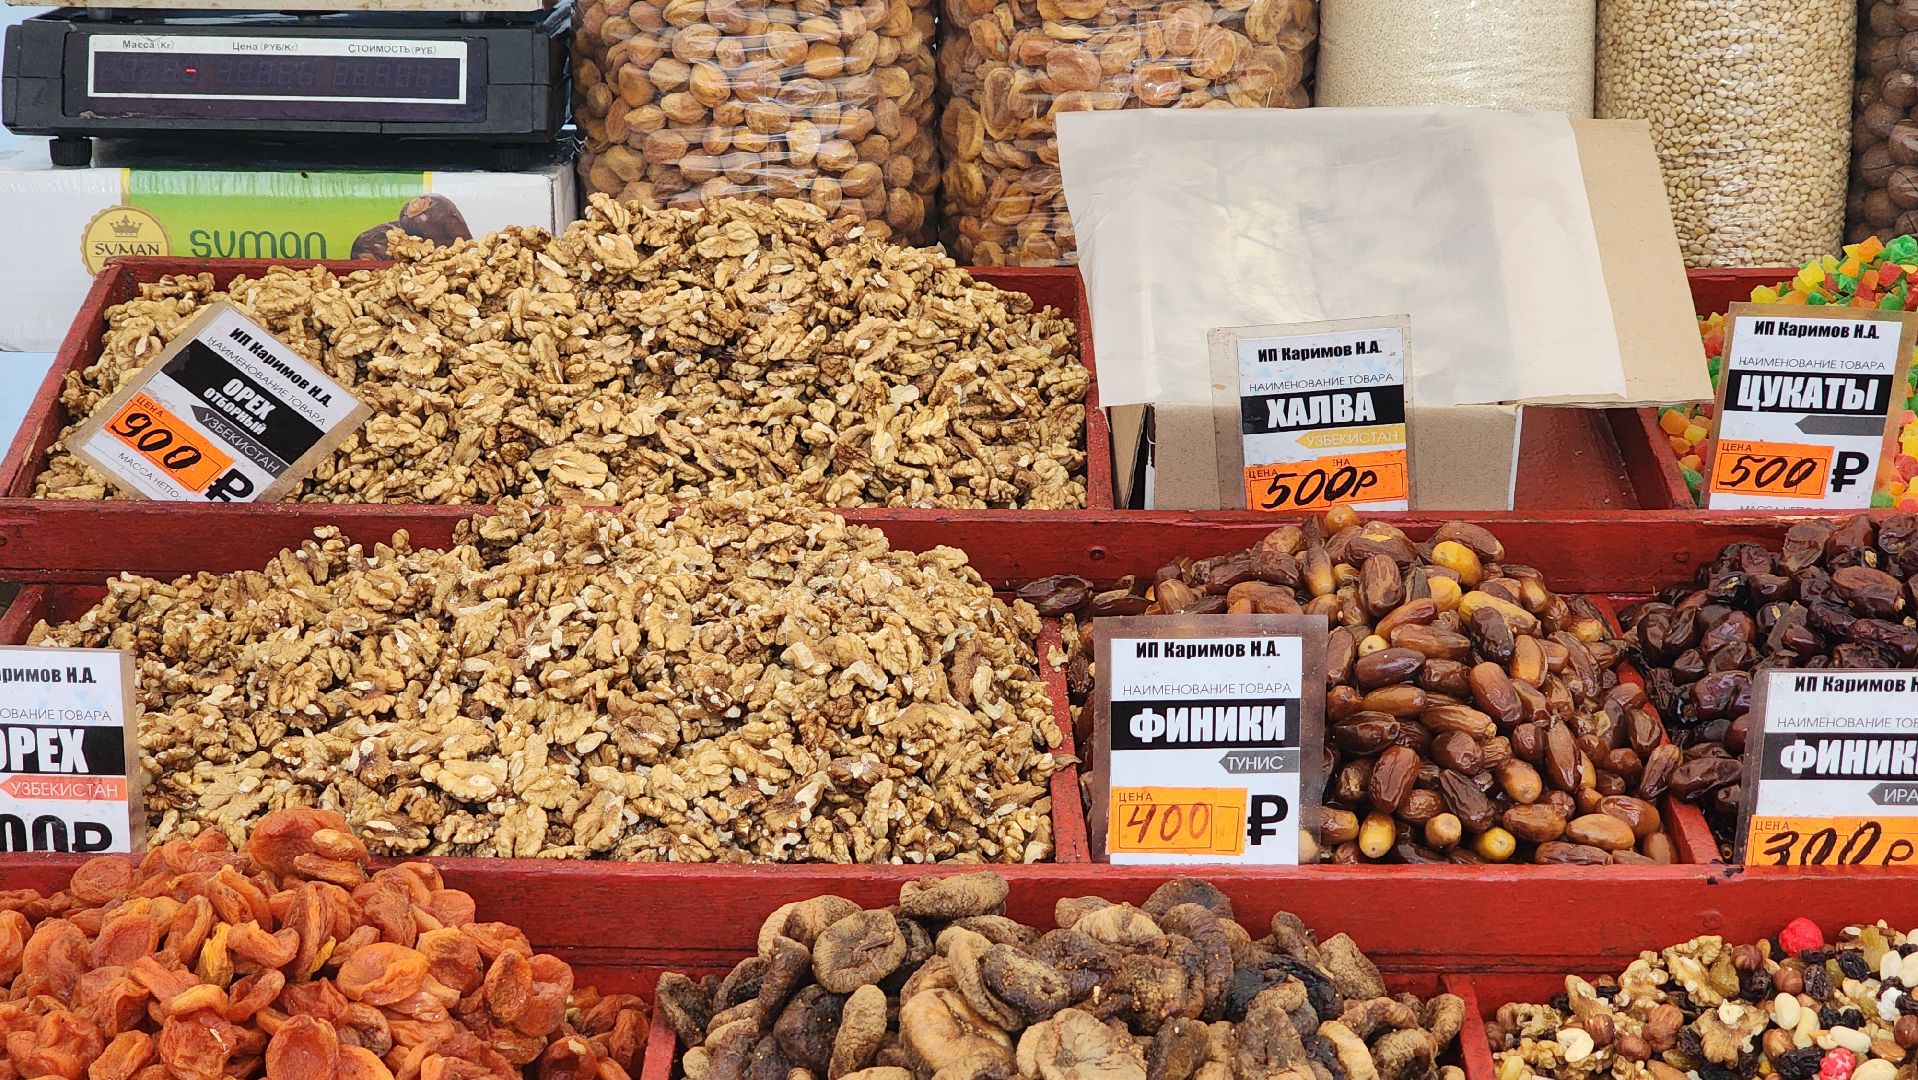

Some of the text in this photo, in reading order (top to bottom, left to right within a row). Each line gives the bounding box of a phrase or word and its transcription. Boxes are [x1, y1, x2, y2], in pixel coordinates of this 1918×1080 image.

[122, 40, 154, 49] Масса
[232, 42, 258, 52] Цена
[1754, 320, 1880, 339] ИП Каримов Н.А.
[229, 328, 252, 347] ИП
[248, 341, 309, 390] Каримов
[1258, 340, 1383, 363] ИП Каримов Н.А.
[1739, 357, 1885, 370] НАИМЕНОВАНИЕ ТОВАРА
[207, 336, 326, 426] НАИМЕНОВАНИЕ ТОВАРА
[1249, 373, 1394, 392] НАИМЕНОВАНИЕ ТОВАРА
[222, 378, 277, 421] ОРЕХ
[1736, 374, 1880, 412] ЦУКАТЫ
[136, 396, 164, 418] ЦЕНА
[203, 387, 268, 436] ОТБОРНЫЙ
[1265, 391, 1377, 429] ХАЛВА
[111, 412, 202, 470] 900
[202, 412, 280, 474] УЗБЕКИСТАН
[1306, 431, 1399, 447] УЗБЕКИСТАН
[1722, 443, 1752, 452] ЦЕНА
[118, 452, 153, 481] МАССА
[1248, 468, 1278, 479] ЦЕНА
[1719, 455, 1817, 489] 500
[1136, 640, 1281, 660] ИП Каримов Н.А.
[0, 666, 97, 683] римов Н.А.
[1123, 682, 1292, 696] НАИМЕНОВАНИЕ ТОВАРА
[1794, 676, 1818, 693] ИП
[1822, 676, 1906, 694] Каримов
[58, 709, 112, 721] ТОВАРА
[1129, 706, 1286, 743] ФИНИКИ
[1777, 717, 1892, 728] НАИМЕНОВАНИЕ
[0, 726, 90, 774] РЕХ
[1780, 739, 1918, 775] ФИНИК
[1227, 756, 1284, 771] ТУНИС
[10, 781, 119, 798] УЗБЕКИСТАН
[1119, 792, 1153, 802] ЦЕНА
[1127, 802, 1210, 844] 400
[1755, 820, 1790, 831] ЦЕНА
